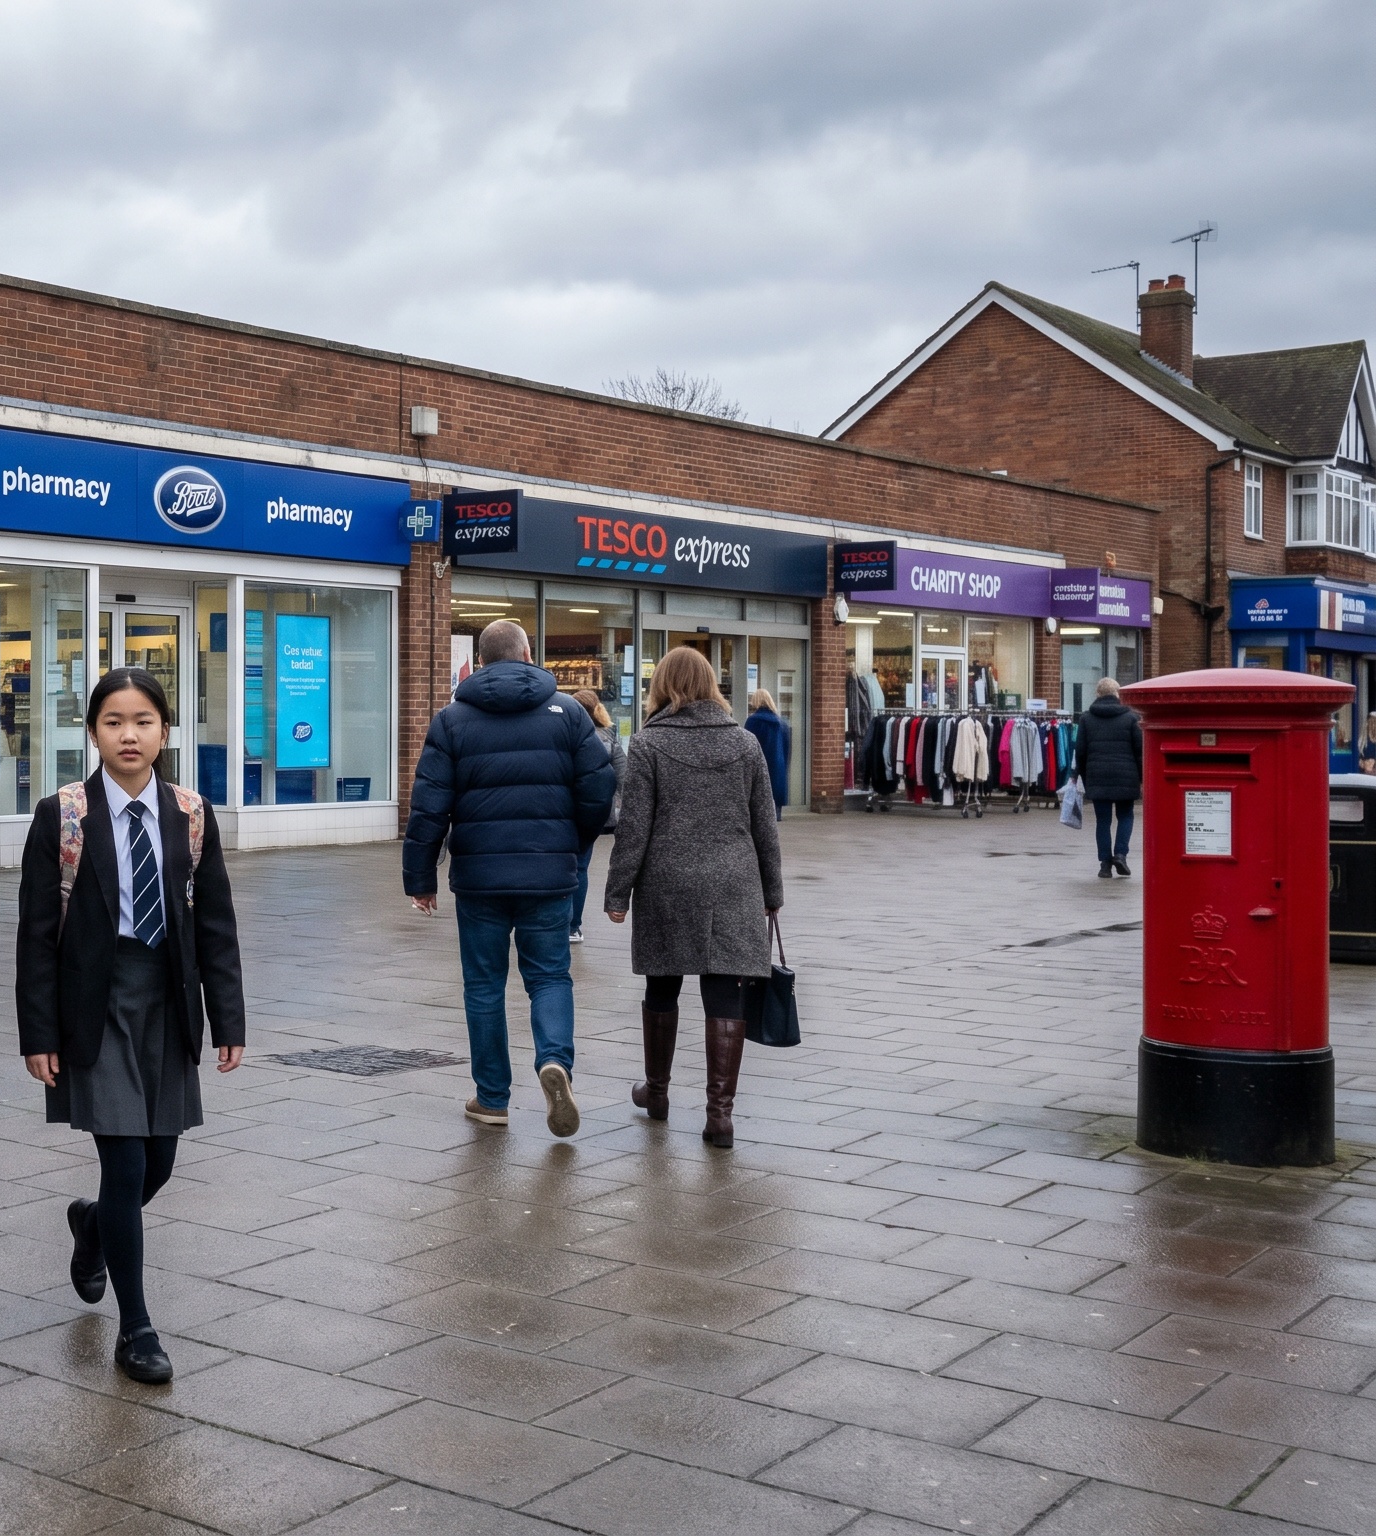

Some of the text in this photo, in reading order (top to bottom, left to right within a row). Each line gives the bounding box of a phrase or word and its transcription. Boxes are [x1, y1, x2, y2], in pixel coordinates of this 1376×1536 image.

[2, 465, 111, 507] pharmacy
[167, 481, 217, 517] Boots
[267, 496, 353, 532] pharmacy
[454, 501, 512, 519] TESCO
[454, 525, 511, 543] express
[577, 516, 751, 574] TESCO express
[841, 551, 889, 563] TESCO
[910, 565, 1001, 599] CHARITY SHOP
